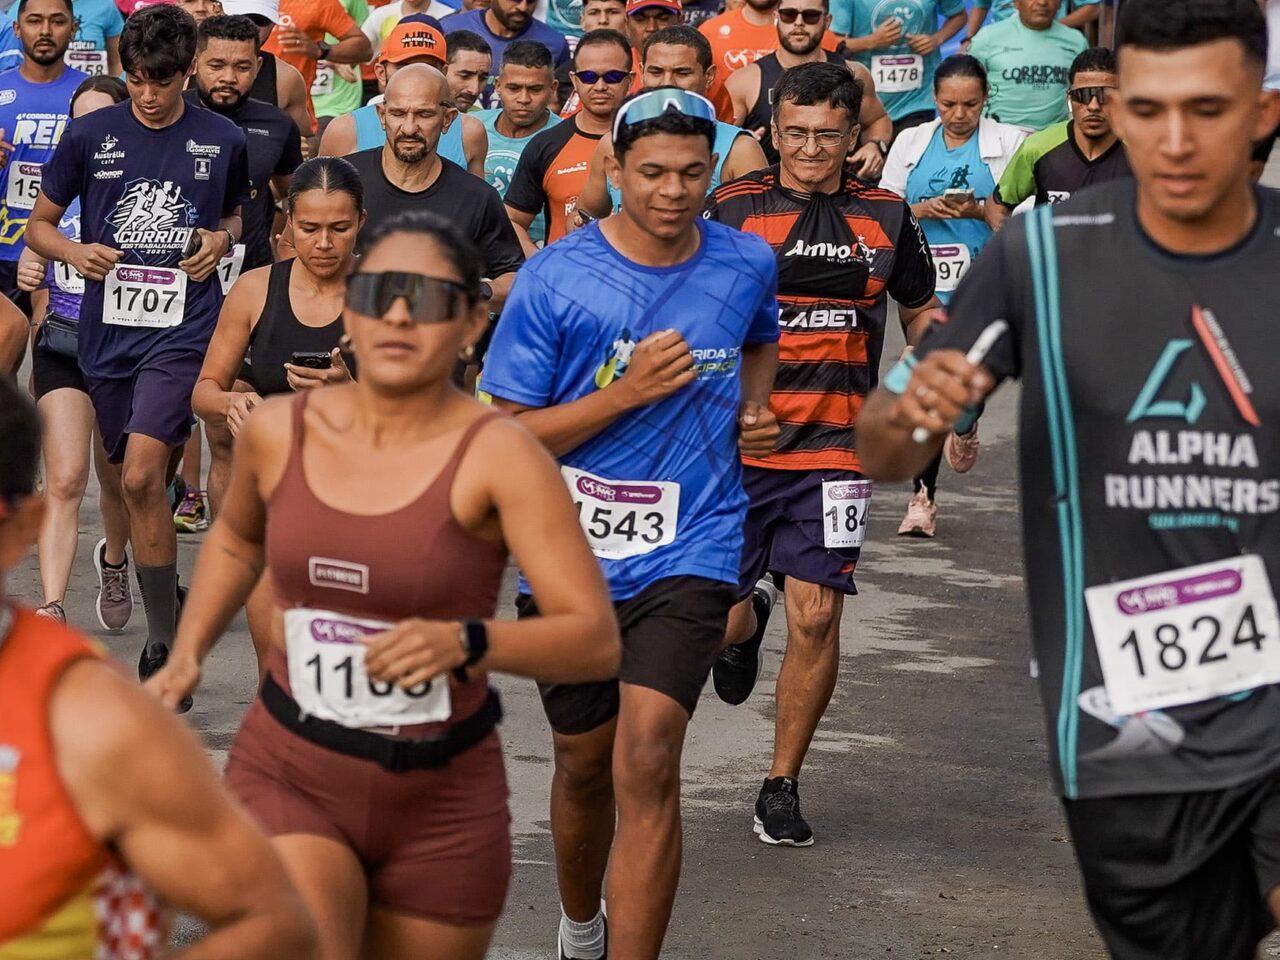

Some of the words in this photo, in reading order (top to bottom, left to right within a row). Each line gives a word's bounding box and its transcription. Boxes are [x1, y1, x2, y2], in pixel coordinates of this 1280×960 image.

[877, 68, 918, 84] 1478
[119, 229, 190, 244] CORRID
[112, 285, 179, 314] 1707
[689, 347, 727, 360] RIDA
[1127, 429, 1260, 468] ALPHA
[1104, 473, 1280, 514] RUNNERS
[1119, 603, 1267, 678] 1824
